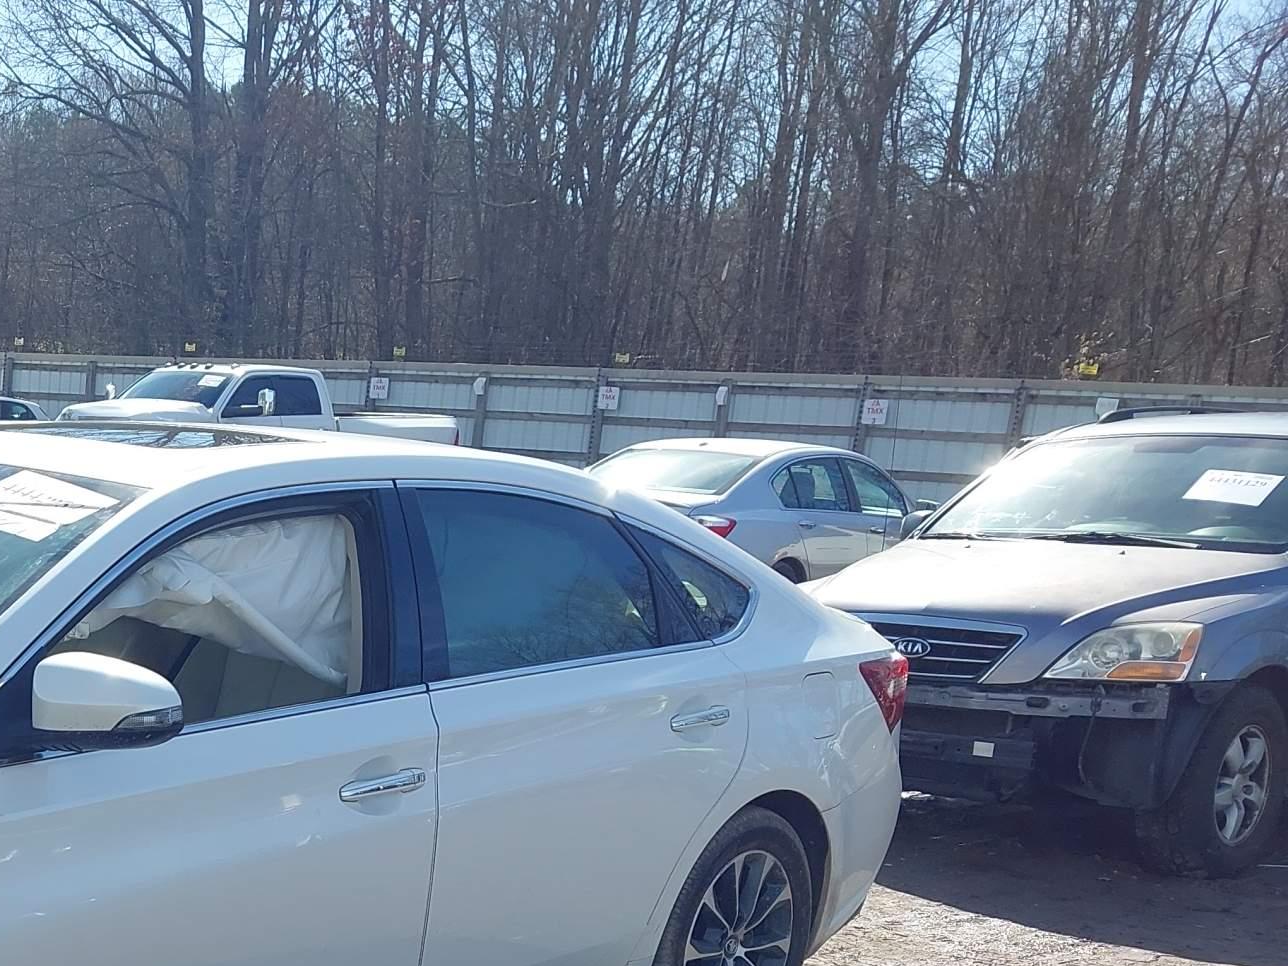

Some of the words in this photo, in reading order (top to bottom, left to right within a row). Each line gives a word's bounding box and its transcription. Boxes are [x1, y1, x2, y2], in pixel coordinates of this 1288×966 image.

[601, 393, 616, 401] TMX
[867, 407, 884, 415] TMX
[897, 641, 923, 654] KIA
